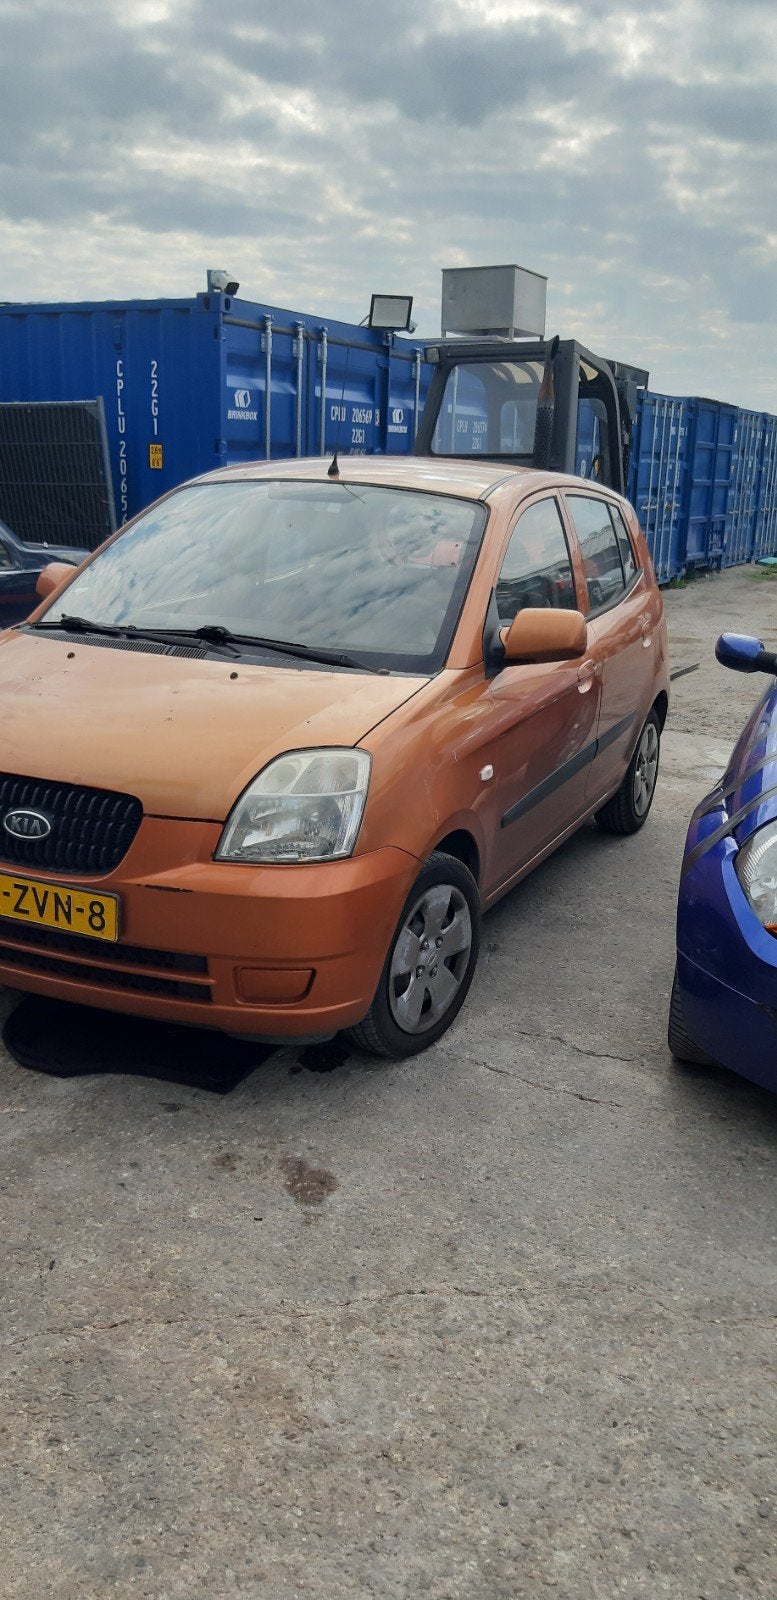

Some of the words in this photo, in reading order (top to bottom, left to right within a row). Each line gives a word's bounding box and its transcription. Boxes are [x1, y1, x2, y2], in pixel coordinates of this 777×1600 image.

[116, 360, 126, 434] CPLU
[150, 360, 159, 436] 22G1
[227, 410, 258, 421] BRINKBOX
[330, 406, 347, 422] CPLU
[351, 408, 373, 424] 206569
[352, 428, 366, 444] 22G1
[10, 816, 41, 835] KIA
[3, 884, 106, 931] -ZVN-8
